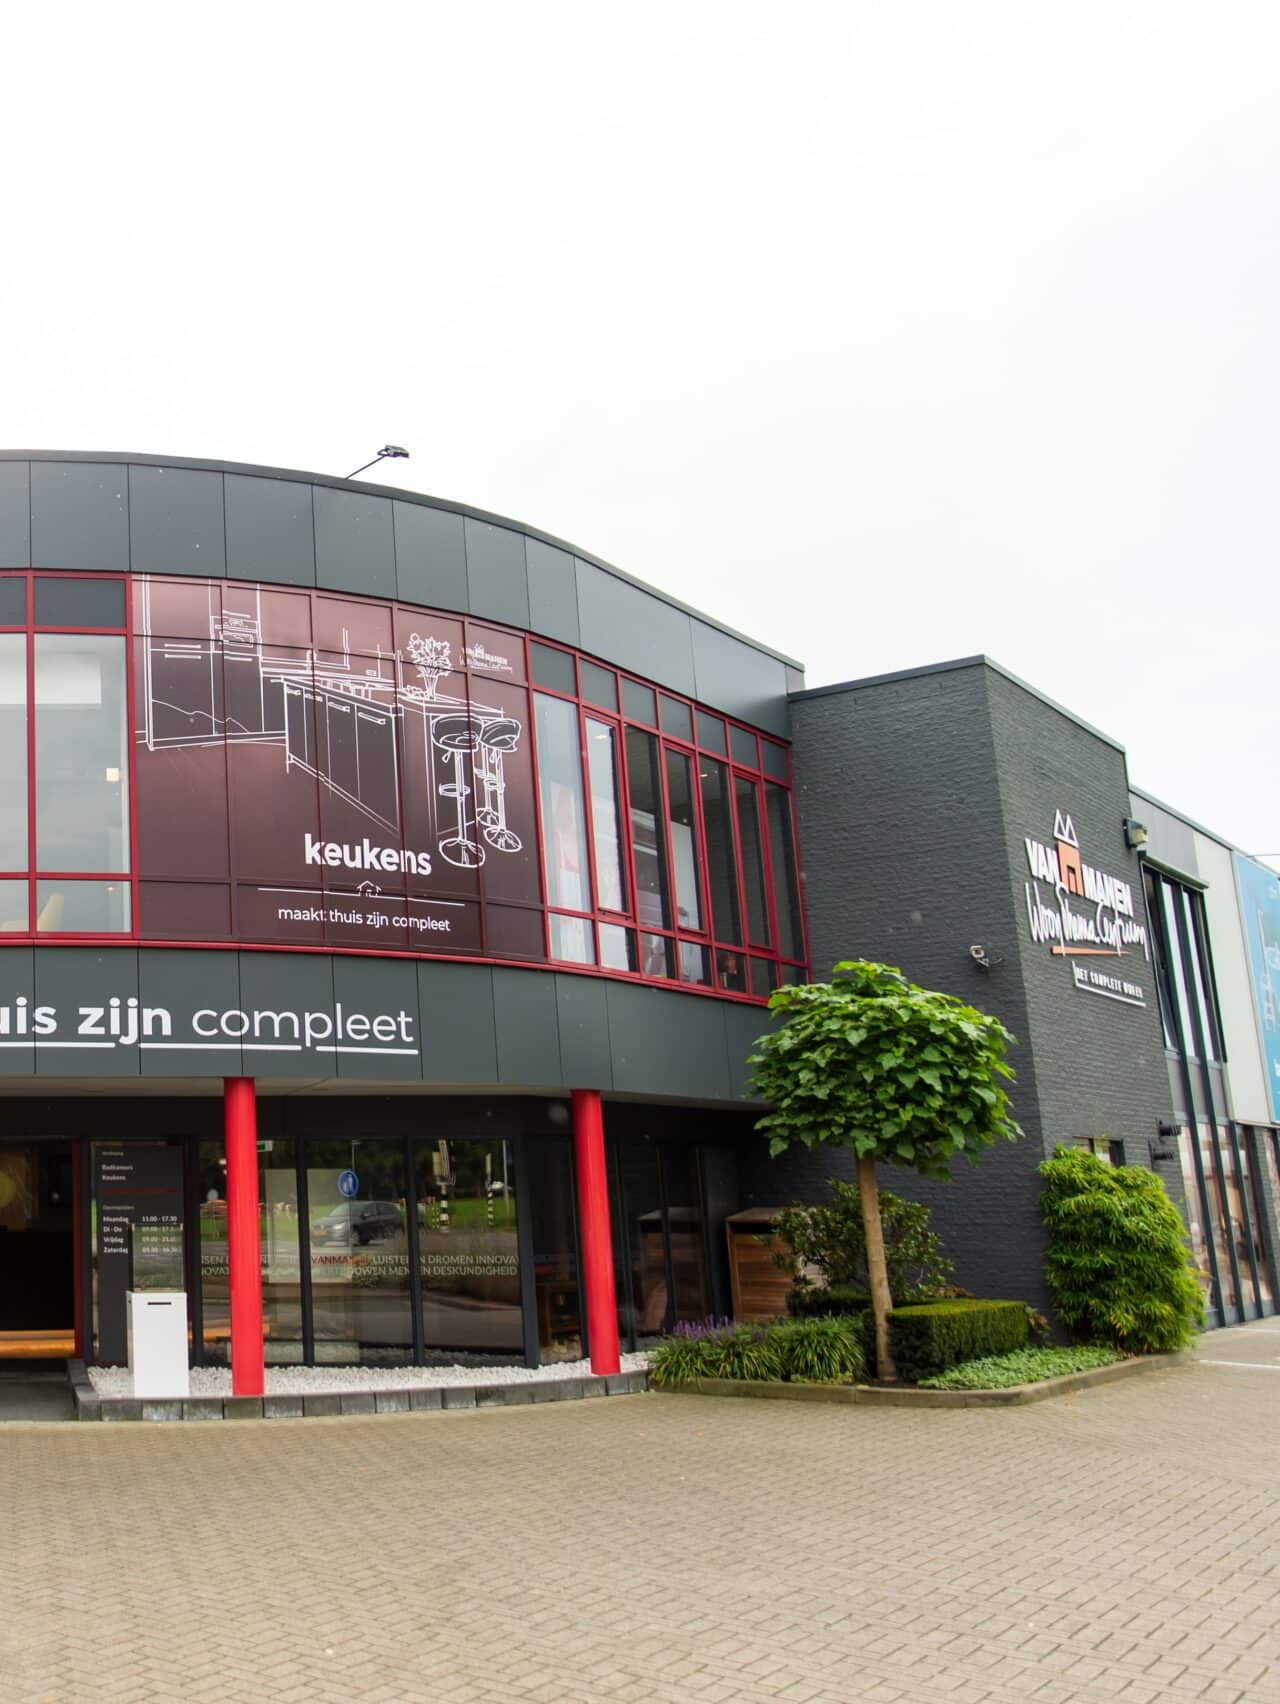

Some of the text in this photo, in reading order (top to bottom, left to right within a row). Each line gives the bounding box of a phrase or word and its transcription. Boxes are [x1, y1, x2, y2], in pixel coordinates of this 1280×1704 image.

[304, 833, 433, 876] keukens
[1024, 837, 1135, 917] VAN MANEN
[278, 907, 452, 932] maakt thuis zijn compleet
[1090, 970, 1122, 993] COMPLETE
[78, 997, 172, 1045] zijn
[192, 1002, 414, 1047] compleet
[427, 1255, 473, 1265] DROMEN
[433, 1265, 518, 1276] DESKUNDIGHEID
